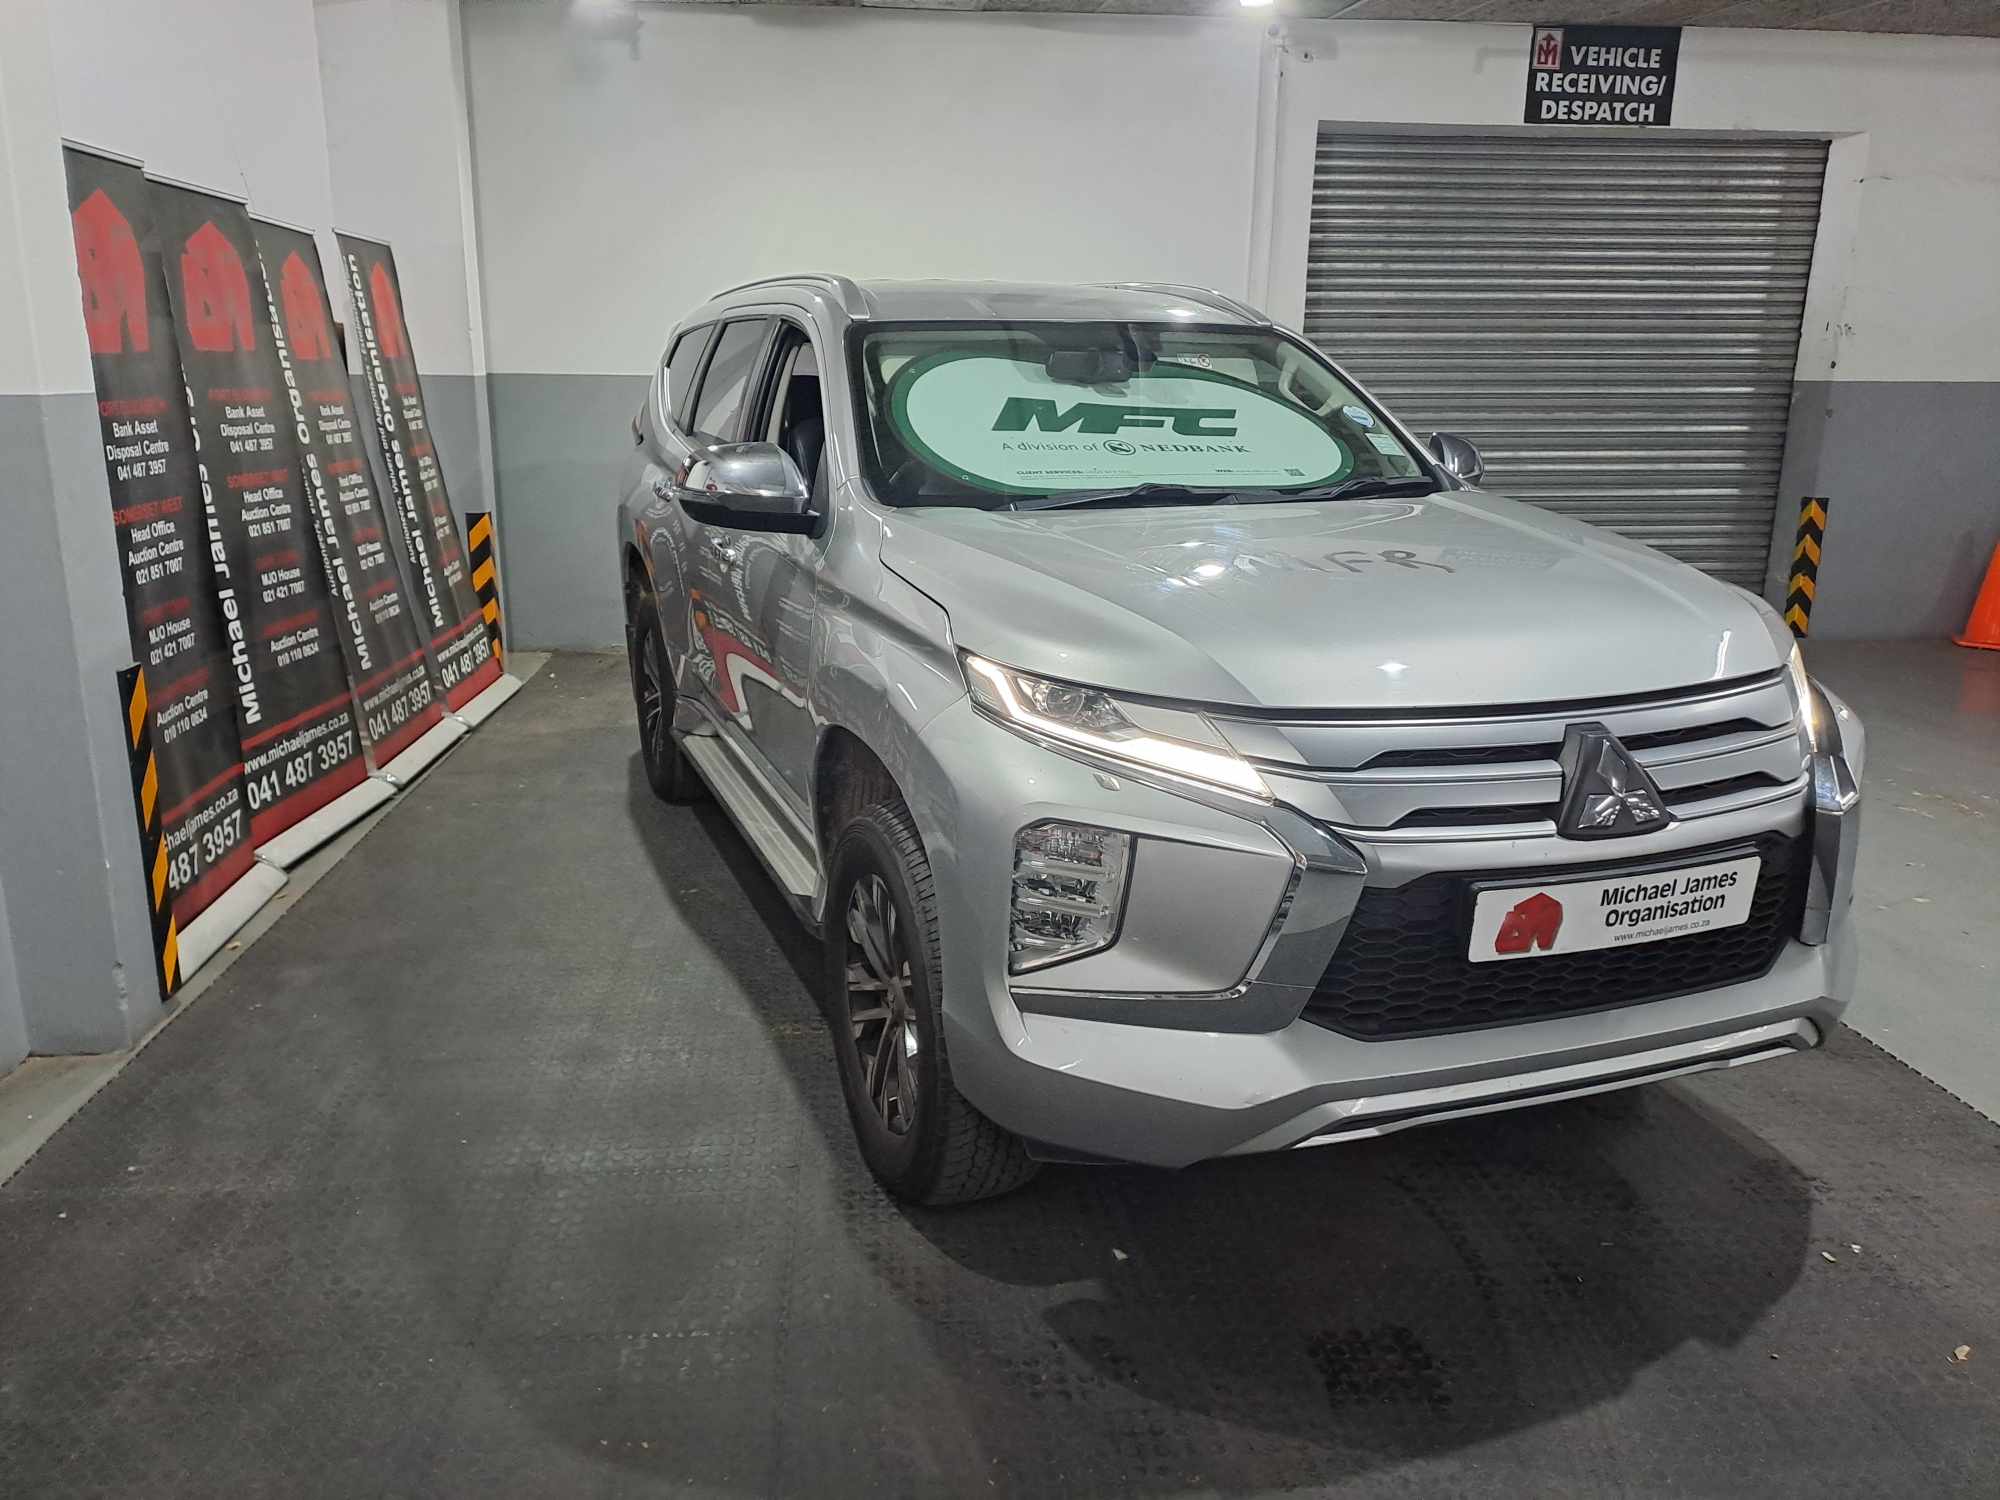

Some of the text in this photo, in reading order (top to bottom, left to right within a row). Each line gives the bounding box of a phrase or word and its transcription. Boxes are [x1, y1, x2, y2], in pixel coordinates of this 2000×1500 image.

[1570, 46, 1662, 68] VEHICLE
[1535, 72, 1667, 96] RECEIVING/
[1541, 100, 1656, 122] DESPATCH
[348, 254, 395, 433] Organisation
[225, 406, 266, 419] Bank Asset
[991, 397, 1237, 437] MFC
[112, 419, 158, 438] Bank Asset
[220, 423, 253, 438] Disposal
[106, 440, 169, 462] Disposal Centre
[230, 441, 244, 453] 041
[1002, 441, 1250, 453] A division of NEDBANK
[117, 459, 166, 480] 041 487 3957
[391, 439, 419, 523] James
[306, 453, 340, 549] James
[241, 507, 270, 522] Auction
[131, 520, 176, 544] Head Office
[248, 524, 262, 538] 021
[128, 539, 184, 566] Auction Centre
[136, 568, 149, 585] 021
[150, 562, 164, 580] 851
[411, 529, 444, 627] Michael
[332, 557, 372, 670] Michael
[166, 617, 191, 637] House
[150, 650, 163, 665] 021
[164, 642, 176, 658] 421
[270, 635, 297, 653] Auction
[218, 588, 262, 725] Michael
[441, 661, 460, 688] 041
[473, 636, 490, 664] 3957
[157, 688, 209, 727] Auction Centre
[368, 680, 431, 741] 041 487 3957
[164, 727, 176, 744] 010
[177, 717, 190, 733] 110
[244, 712, 349, 775] www.michaeljames.co.za
[247, 730, 353, 810] 041 487 3957
[168, 808, 242, 890] 487 3957
[1600, 871, 1738, 906] Michael James
[1605, 893, 1725, 927] Organisation
[1614, 919, 1710, 942] www.michaeljames.co.za
